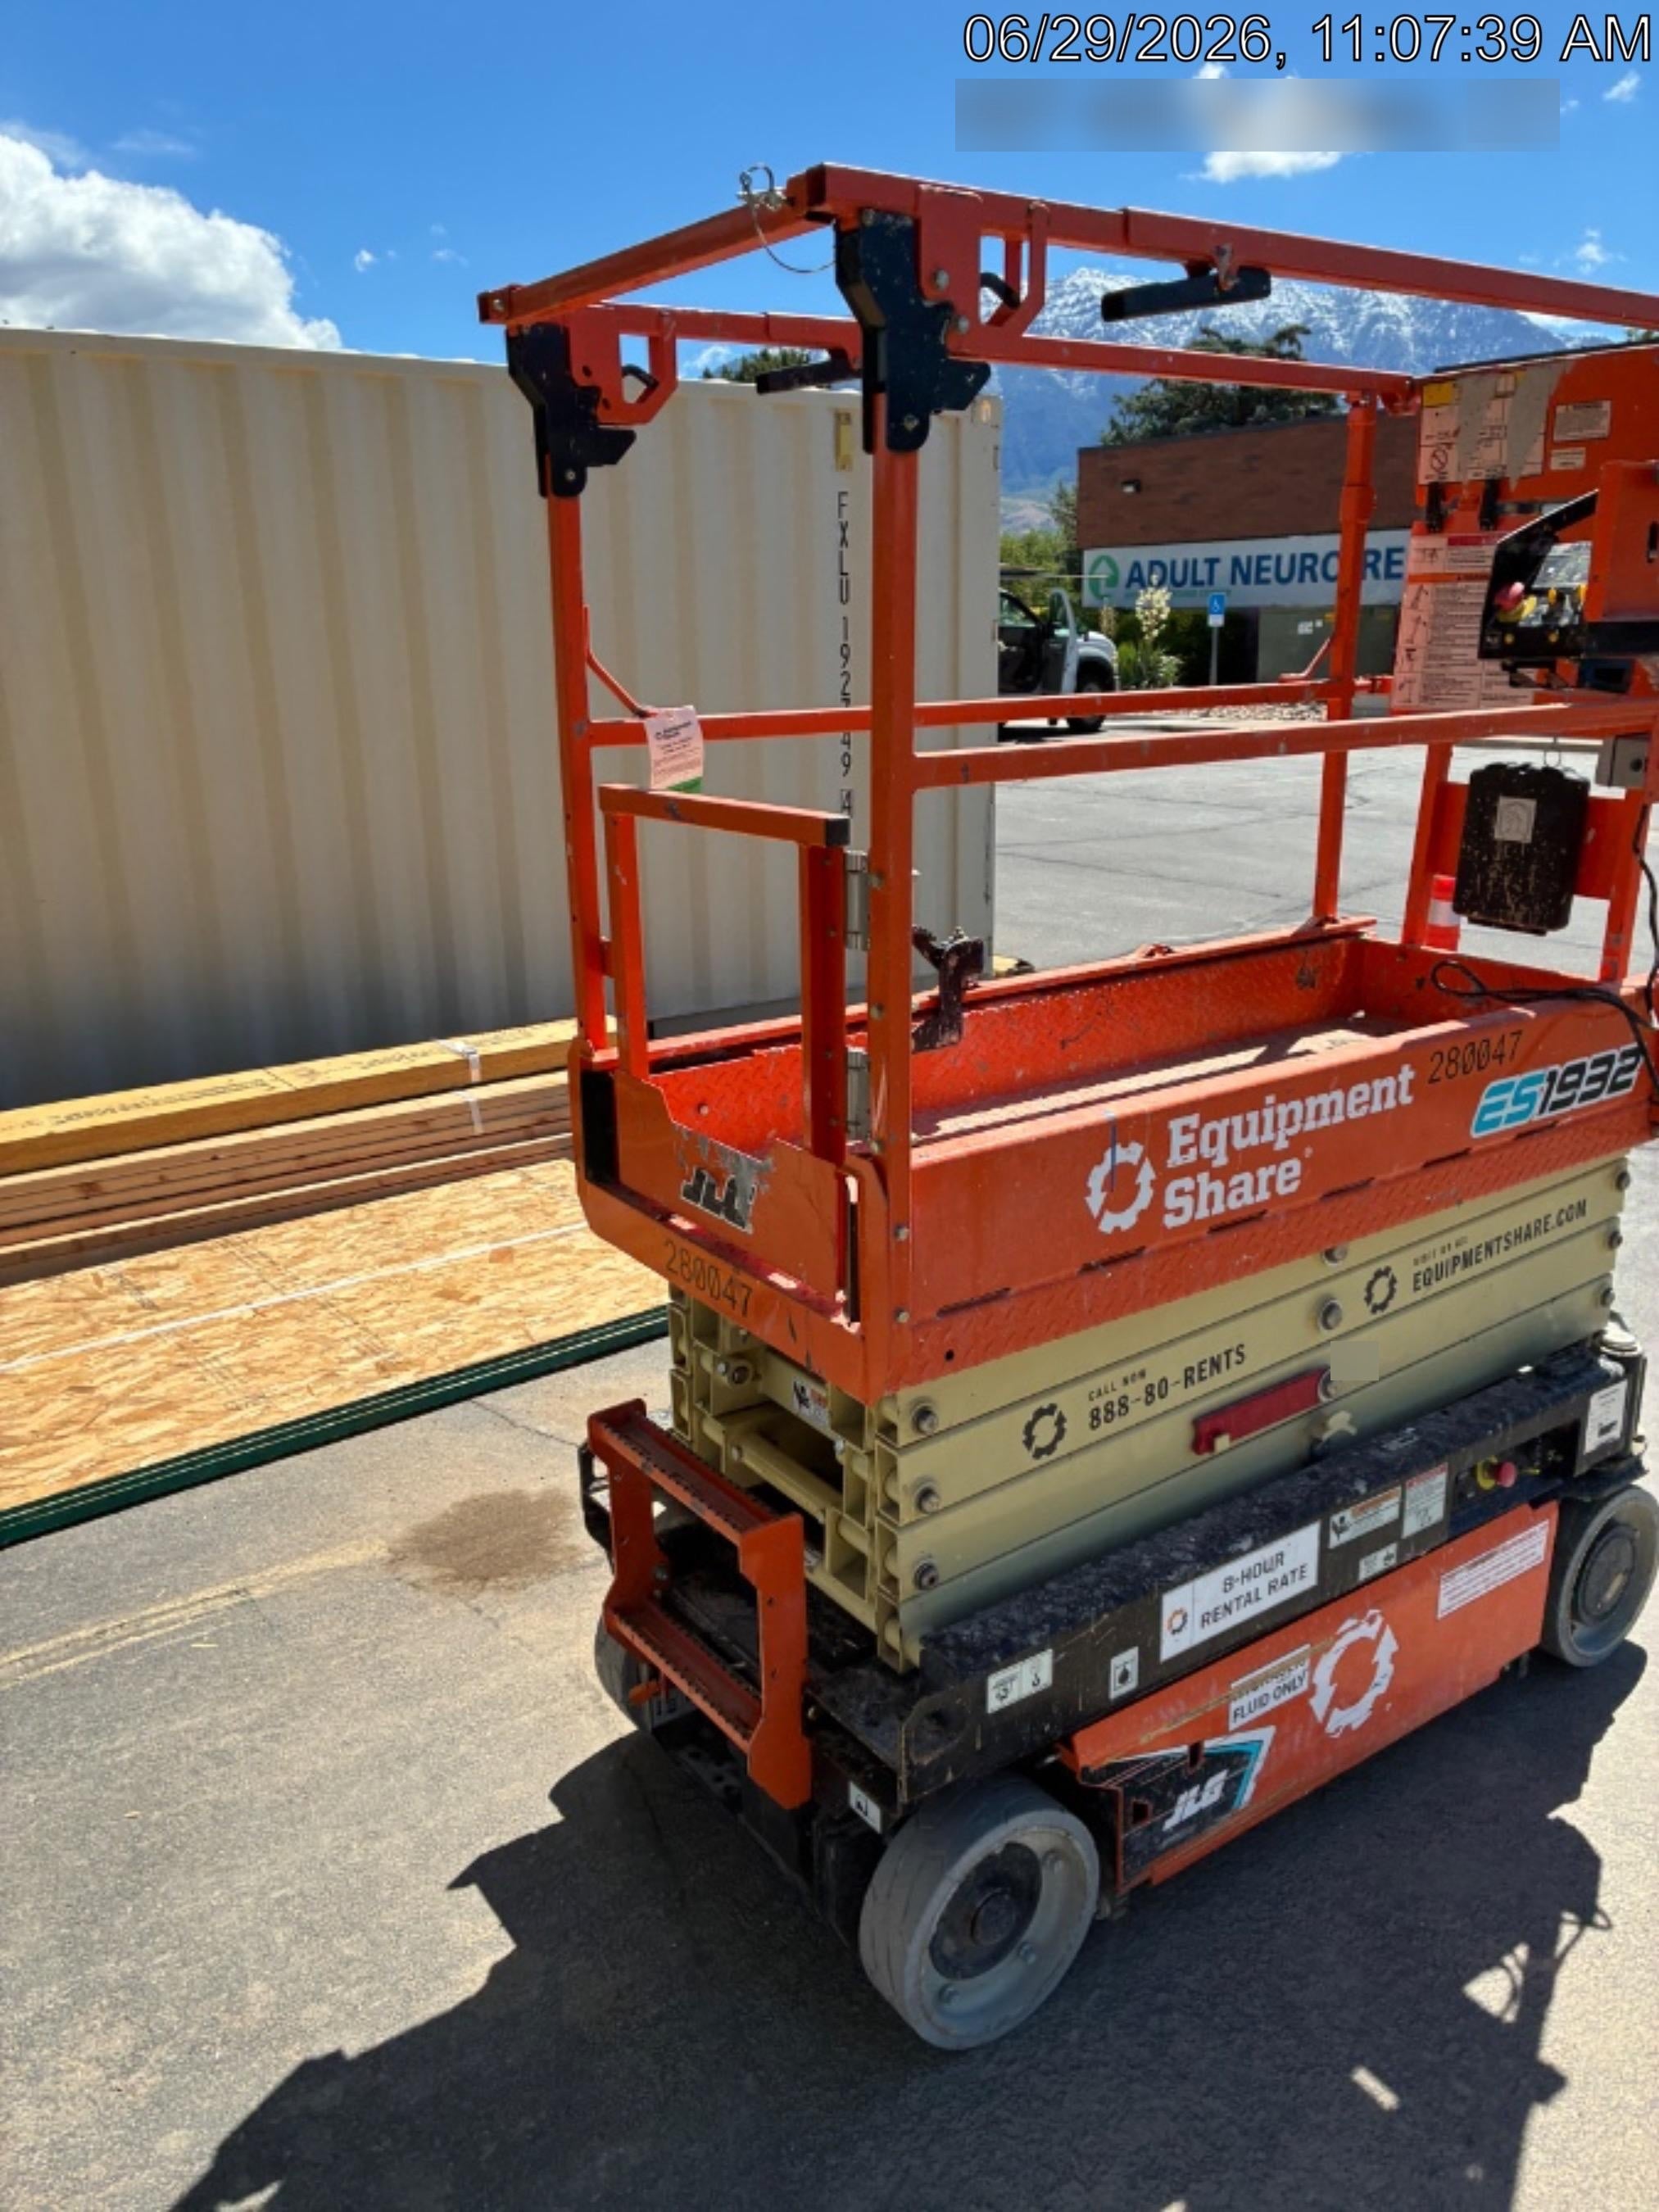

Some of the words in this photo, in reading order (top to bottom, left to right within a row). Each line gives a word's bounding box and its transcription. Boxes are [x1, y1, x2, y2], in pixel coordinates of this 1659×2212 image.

[837, 491, 850, 605] FXLU
[1125, 556, 1221, 589] ADULT
[1428, 1029, 1523, 1085] 280047
[1470, 1042, 1643, 1138] ES1932
[1167, 1067, 1415, 1169] Equipment
[1163, 1158, 1303, 1229] Share
[664, 1239, 752, 1317] 280047
[1412, 1199, 1587, 1292] EQUIPMENTSHARE.COM
[1089, 1344, 1246, 1430] 888-80-RENTS
[1201, 1588, 1261, 1630] RENTAL
[1267, 1563, 1308, 1596] RATE
[1233, 1693, 1269, 1724] FLUID
[1272, 1668, 1306, 1701] ONLY
[1162, 1769, 1228, 1832] JLG
